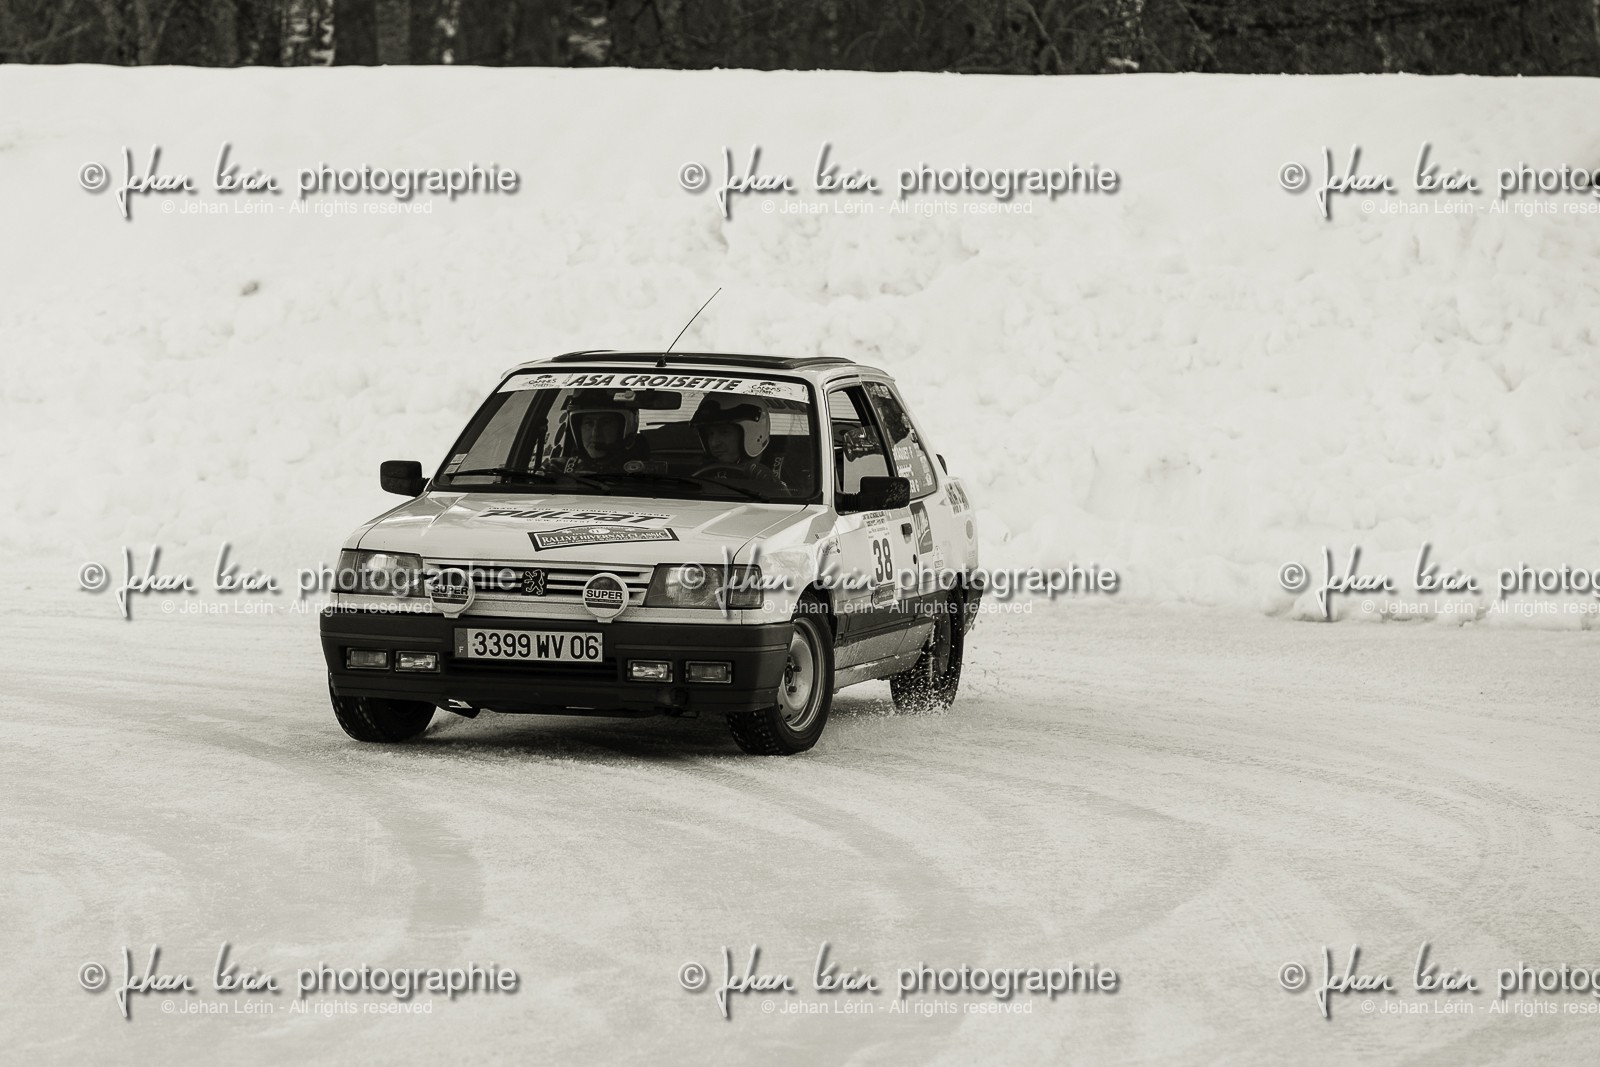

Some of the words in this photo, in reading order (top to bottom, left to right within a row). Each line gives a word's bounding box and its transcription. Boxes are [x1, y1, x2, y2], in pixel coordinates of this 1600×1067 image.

[567, 374, 615, 386] ASA
[620, 374, 742, 391] CROISETTE
[541, 535, 577, 544] RALLYE
[580, 533, 625, 542] HIVERNAL
[628, 531, 665, 540] CLASSIC
[873, 538, 893, 583] 38
[433, 585, 468, 595] SUPER
[586, 590, 623, 600] SUPER
[473, 632, 531, 658] 3399
[536, 634, 564, 659] WV
[570, 635, 600, 660] 06
